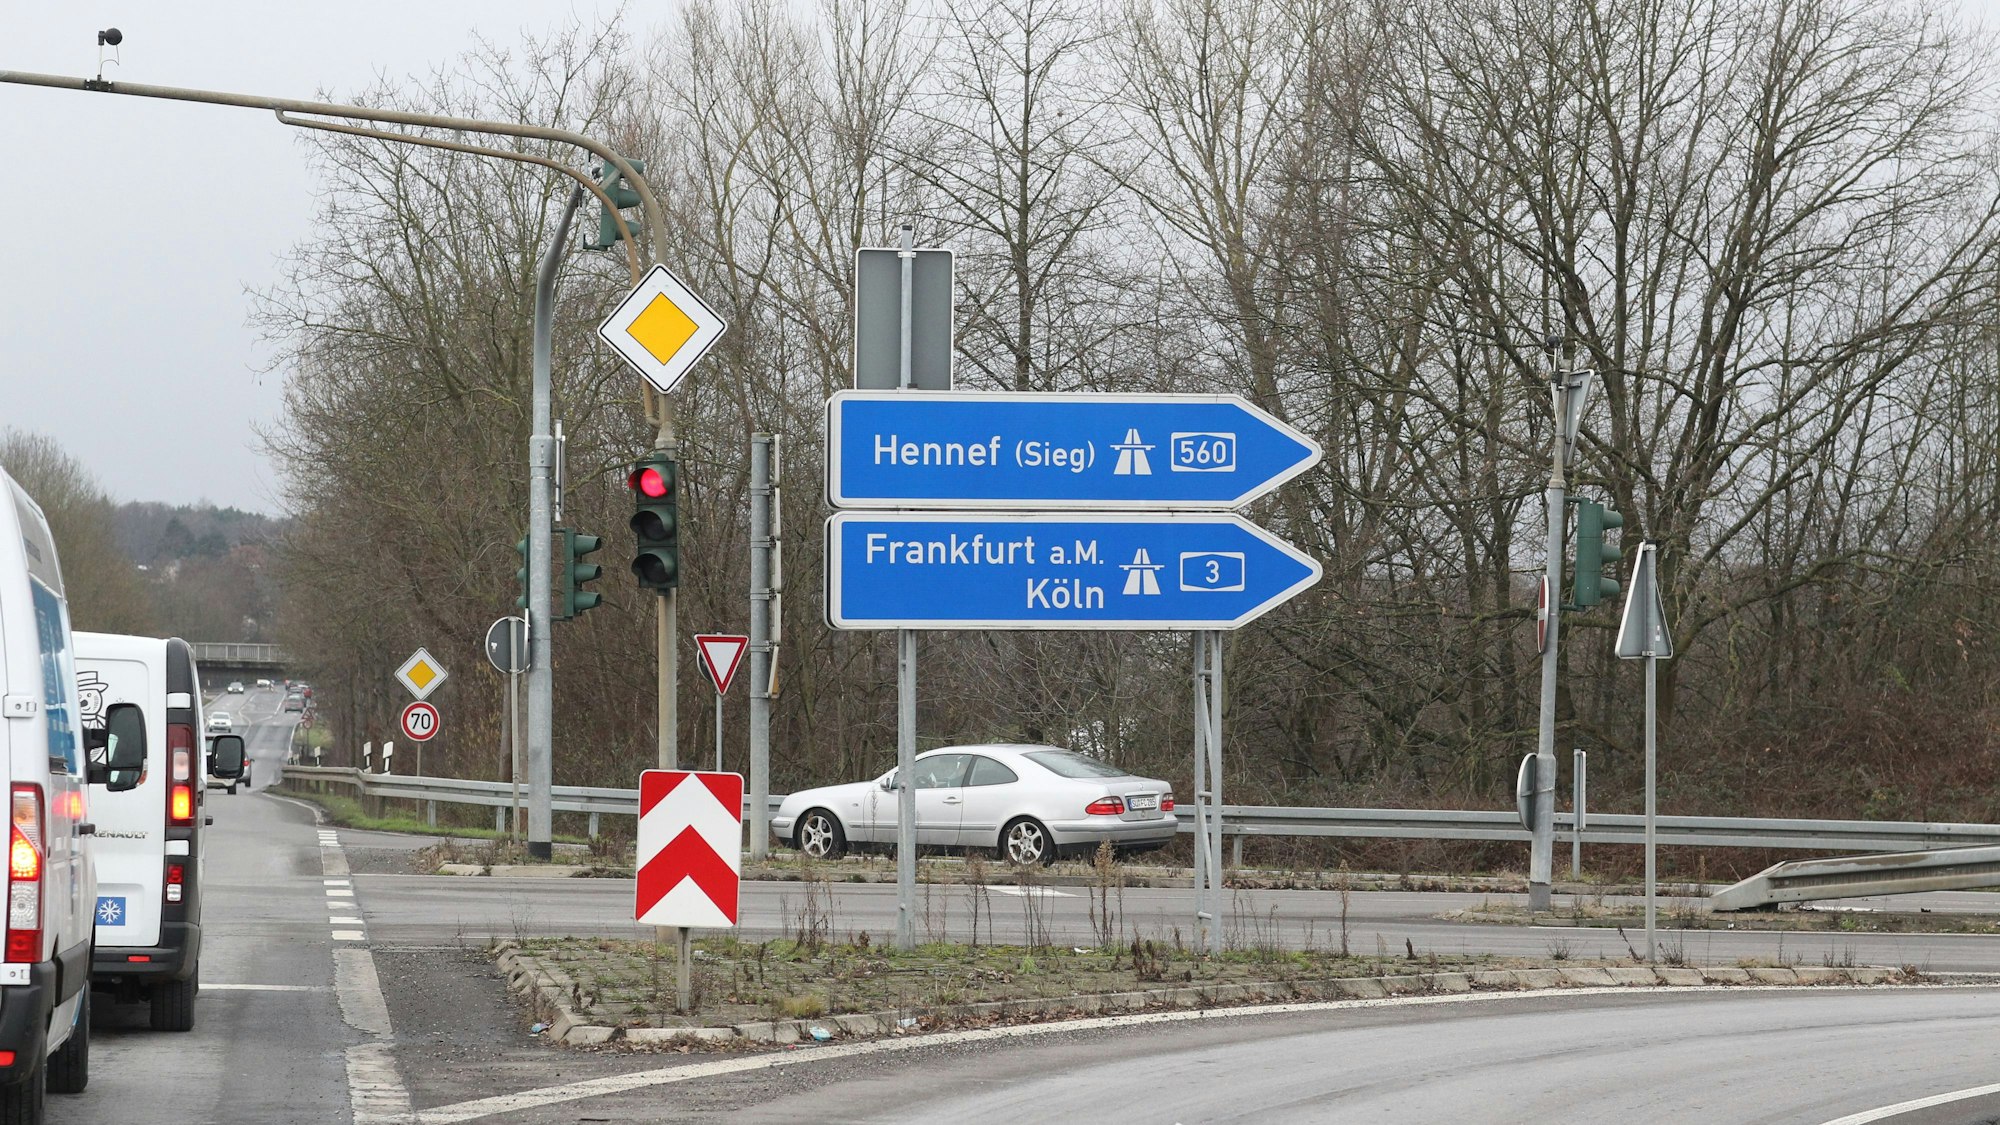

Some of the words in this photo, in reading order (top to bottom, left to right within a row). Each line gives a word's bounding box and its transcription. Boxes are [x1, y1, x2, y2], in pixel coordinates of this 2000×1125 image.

[874, 434, 1001, 466] Hennef
[1015, 440, 1096, 474] (Sieg)
[1180, 440, 1227, 465] 560
[866, 533, 1035, 565] Frankfurt
[1049, 539, 1104, 565] a.M.
[1205, 561, 1220, 584] 3
[1027, 578, 1104, 609] Köln
[411, 713, 431, 730] 70
